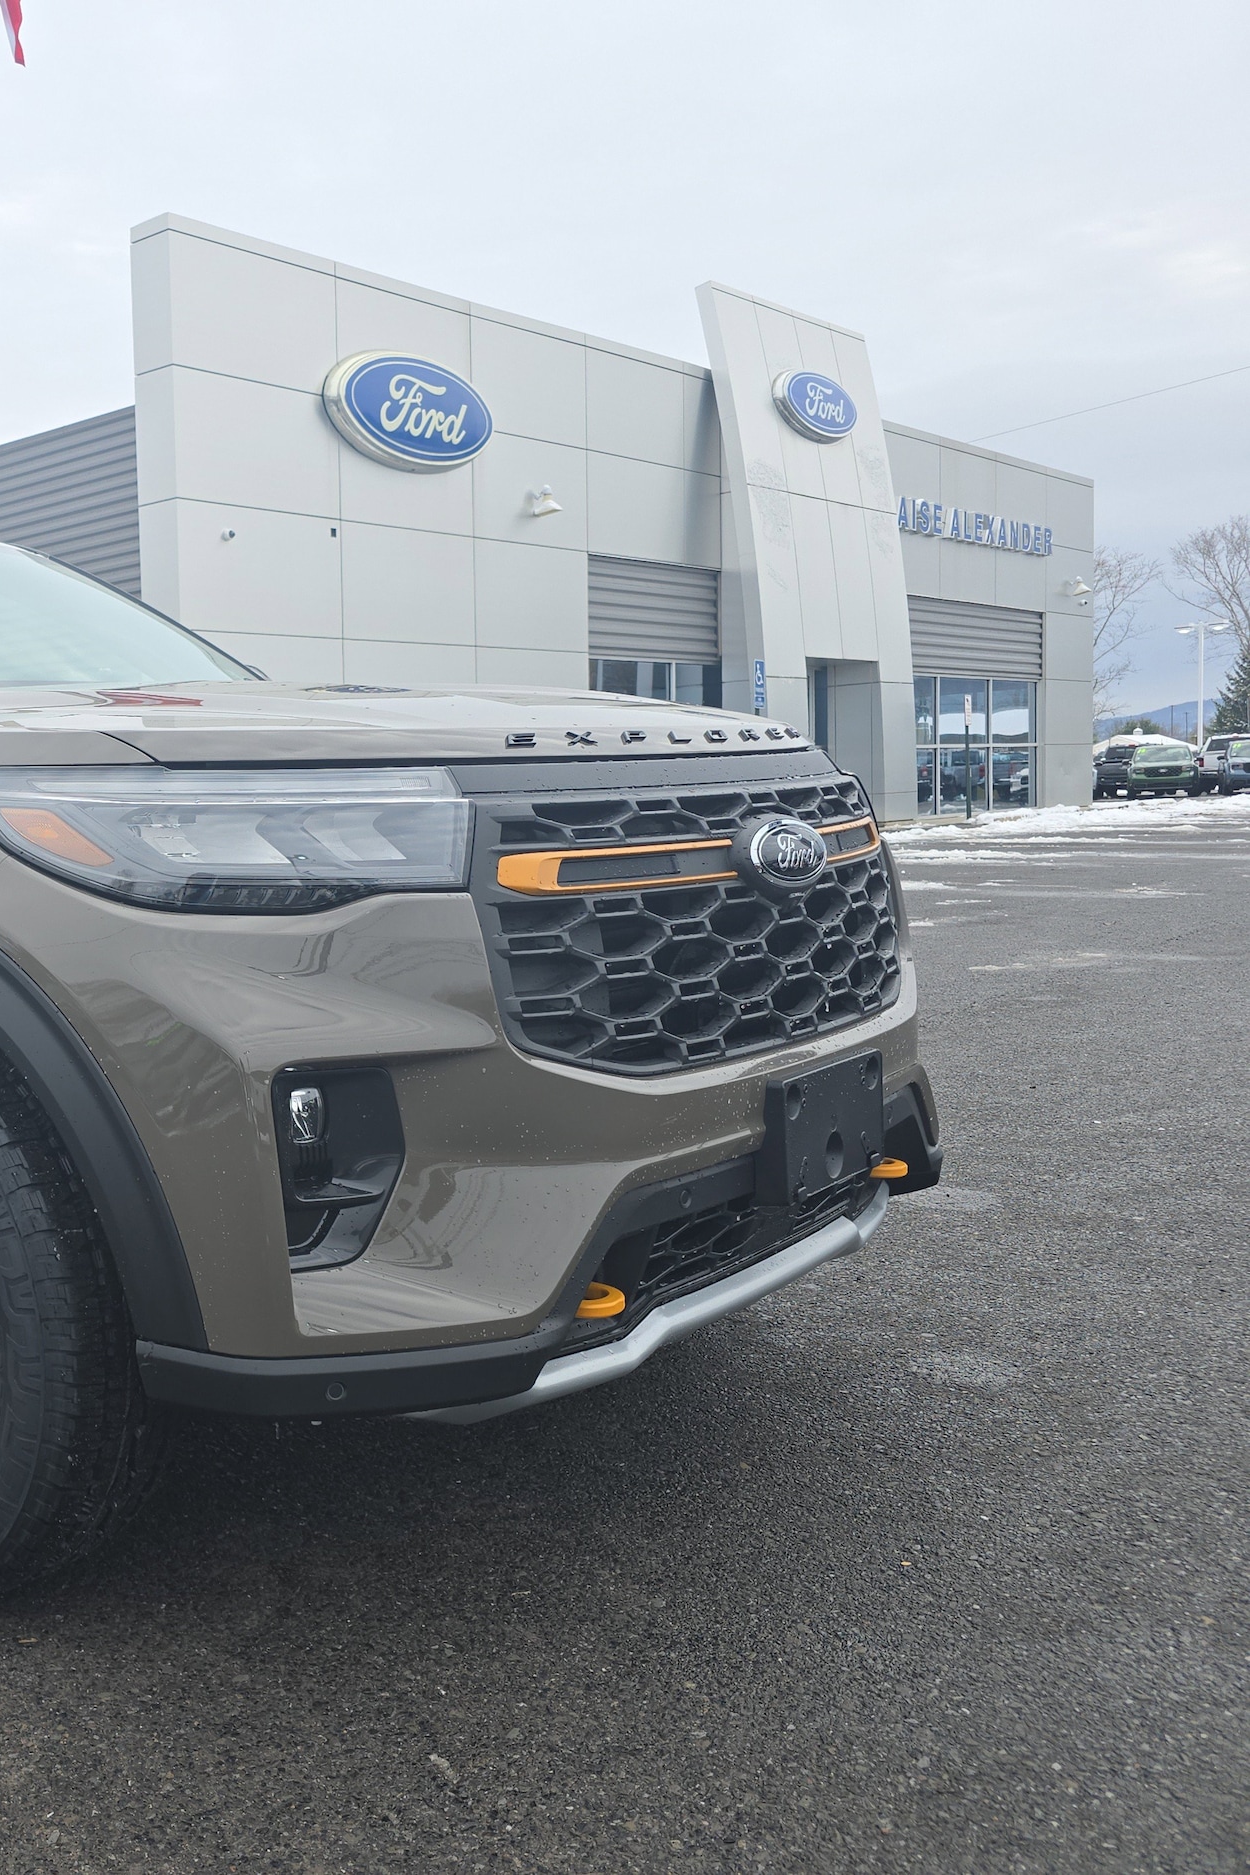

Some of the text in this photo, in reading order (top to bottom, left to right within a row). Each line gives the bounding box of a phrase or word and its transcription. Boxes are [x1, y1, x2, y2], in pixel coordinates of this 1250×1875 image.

[380, 374, 467, 445] Ford
[806, 382, 846, 424] Ford
[951, 507, 1053, 556] ALEXANDER
[504, 726, 801, 748] EXPLORER
[777, 833, 818, 871] Ford
